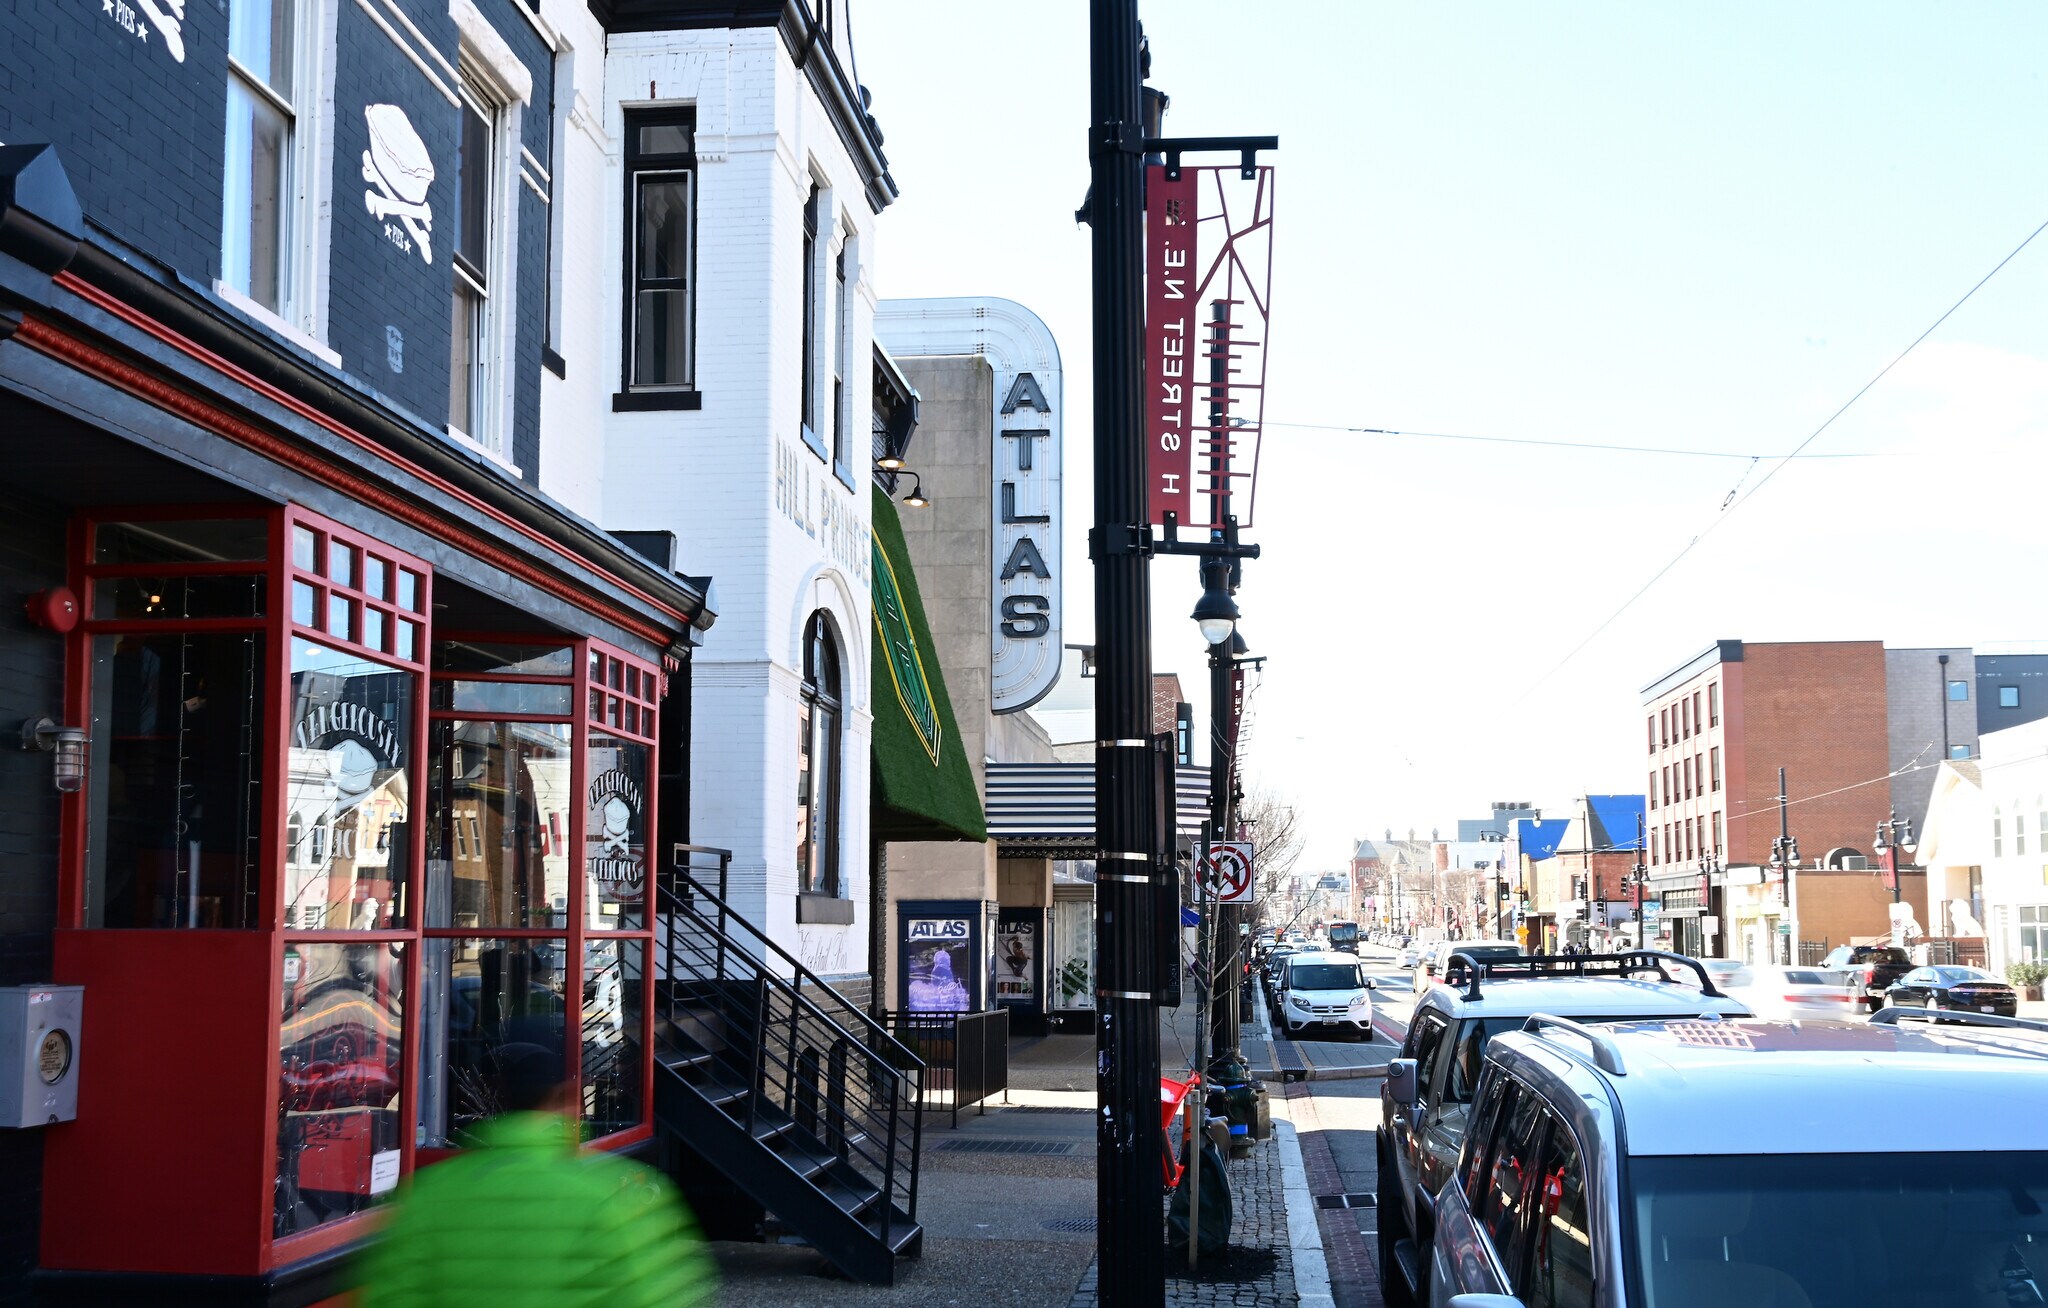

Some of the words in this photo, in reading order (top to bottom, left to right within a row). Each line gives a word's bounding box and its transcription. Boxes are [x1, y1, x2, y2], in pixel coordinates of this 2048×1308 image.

[116, 0, 136, 34] PIES
[392, 224, 404, 250] PIES
[776, 432, 816, 541] HILL
[821, 478, 870, 589] PRINCE
[1000, 372, 1052, 639] ATLAS
[911, 920, 967, 937] ATLAS
[997, 922, 1033, 935] TLAS
